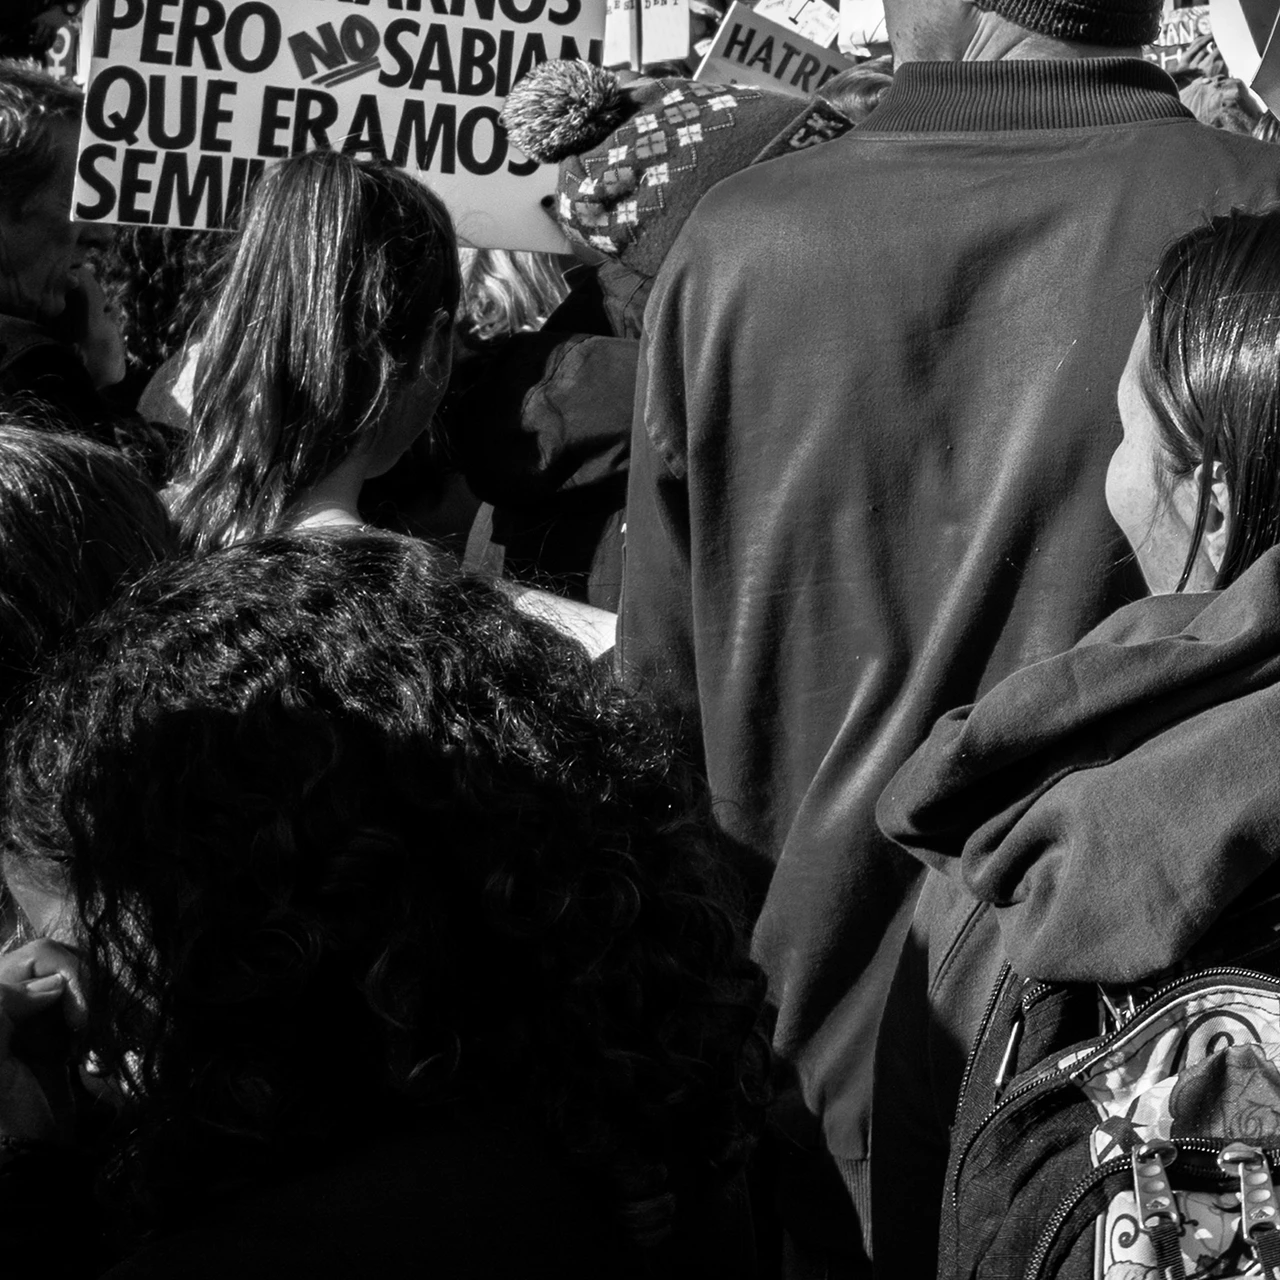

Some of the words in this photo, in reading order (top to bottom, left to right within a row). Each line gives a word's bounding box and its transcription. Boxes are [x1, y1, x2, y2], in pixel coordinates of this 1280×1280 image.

[286, 13, 381, 82] NO
[84, 64, 238, 154] QUE
[75, 143, 266, 230] SEMI
